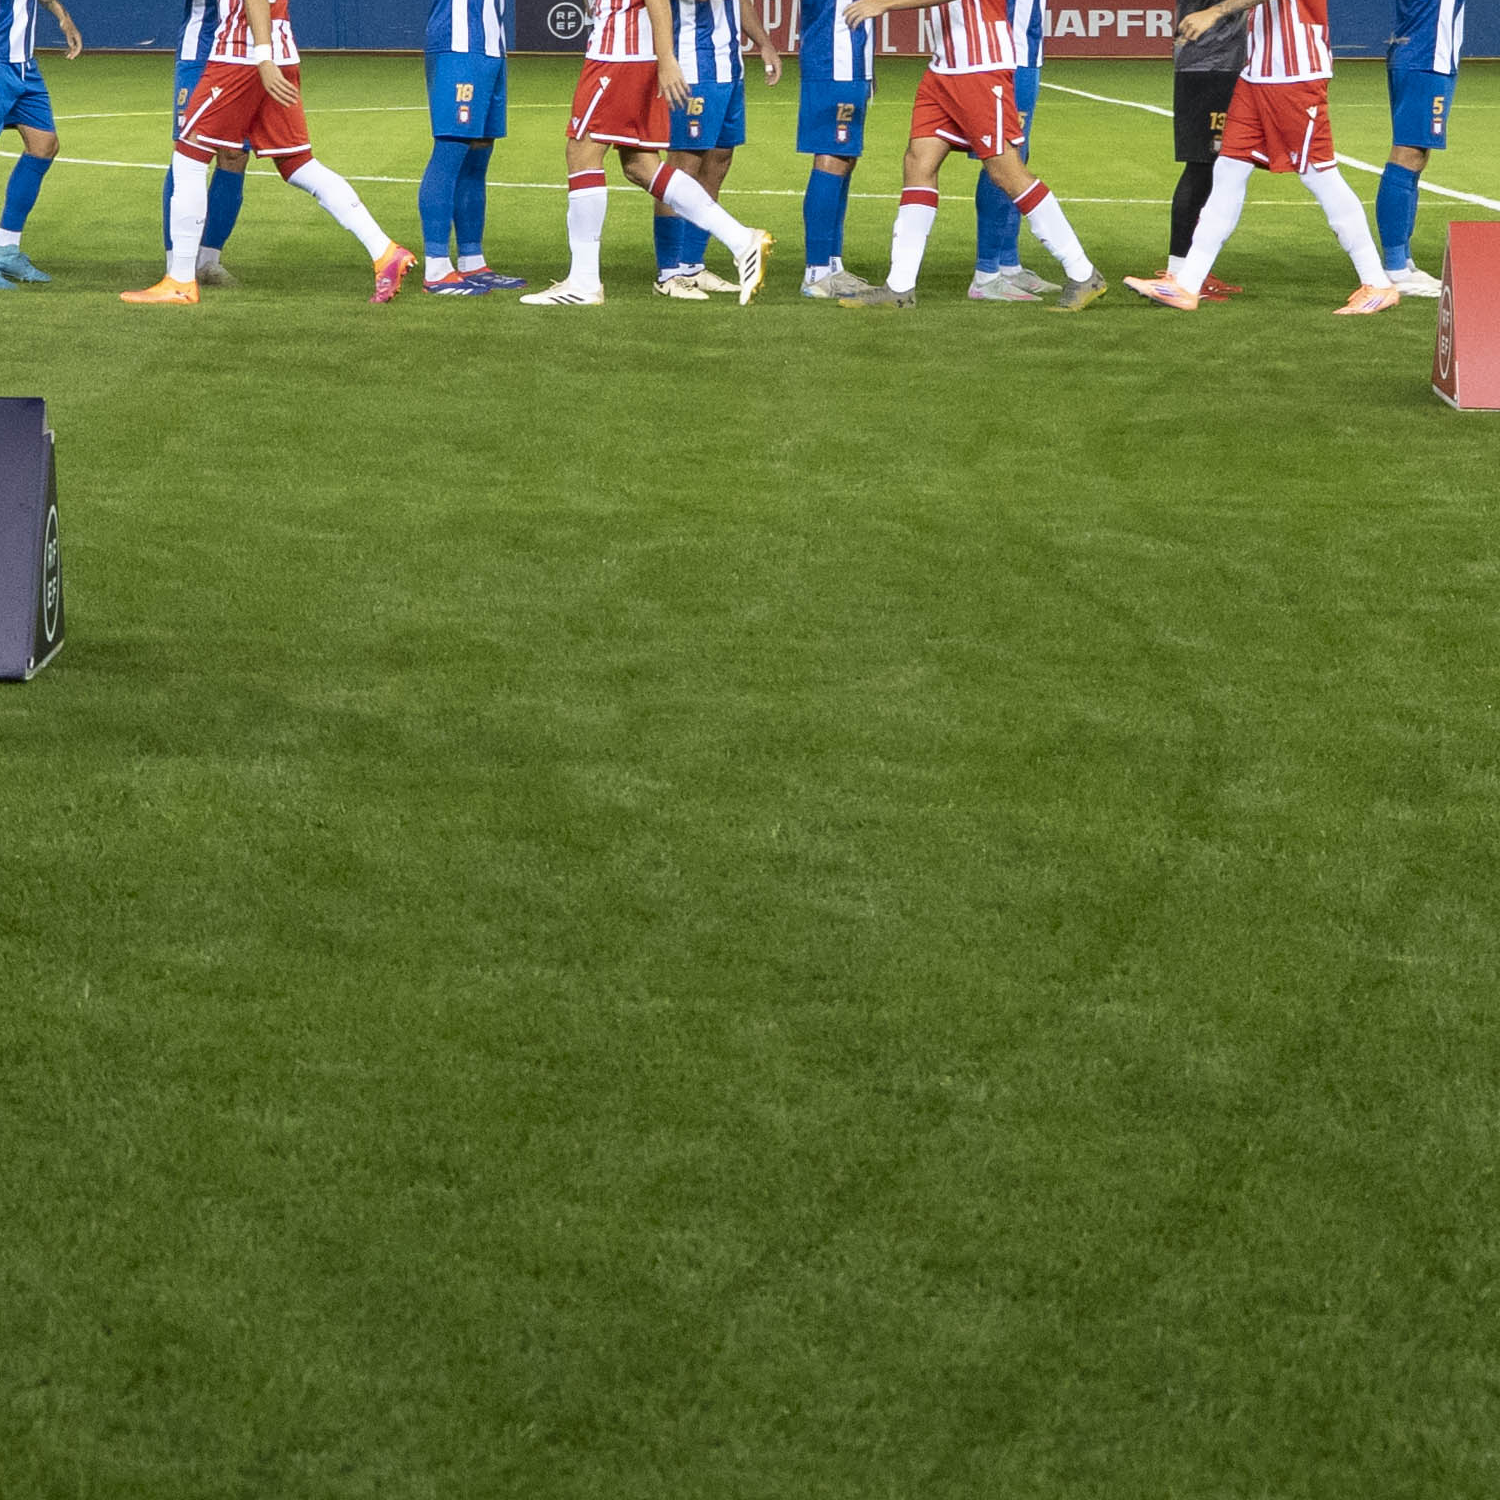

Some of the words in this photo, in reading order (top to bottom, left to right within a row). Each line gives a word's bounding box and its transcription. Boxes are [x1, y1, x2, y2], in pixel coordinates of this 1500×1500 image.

[555, 10, 577, 21] RF
[555, 21, 577, 32] EF
[455, 83, 474, 102] 18
[686, 97, 705, 116] 16
[837, 103, 855, 122] 12
[1432, 96, 1445, 115] 5
